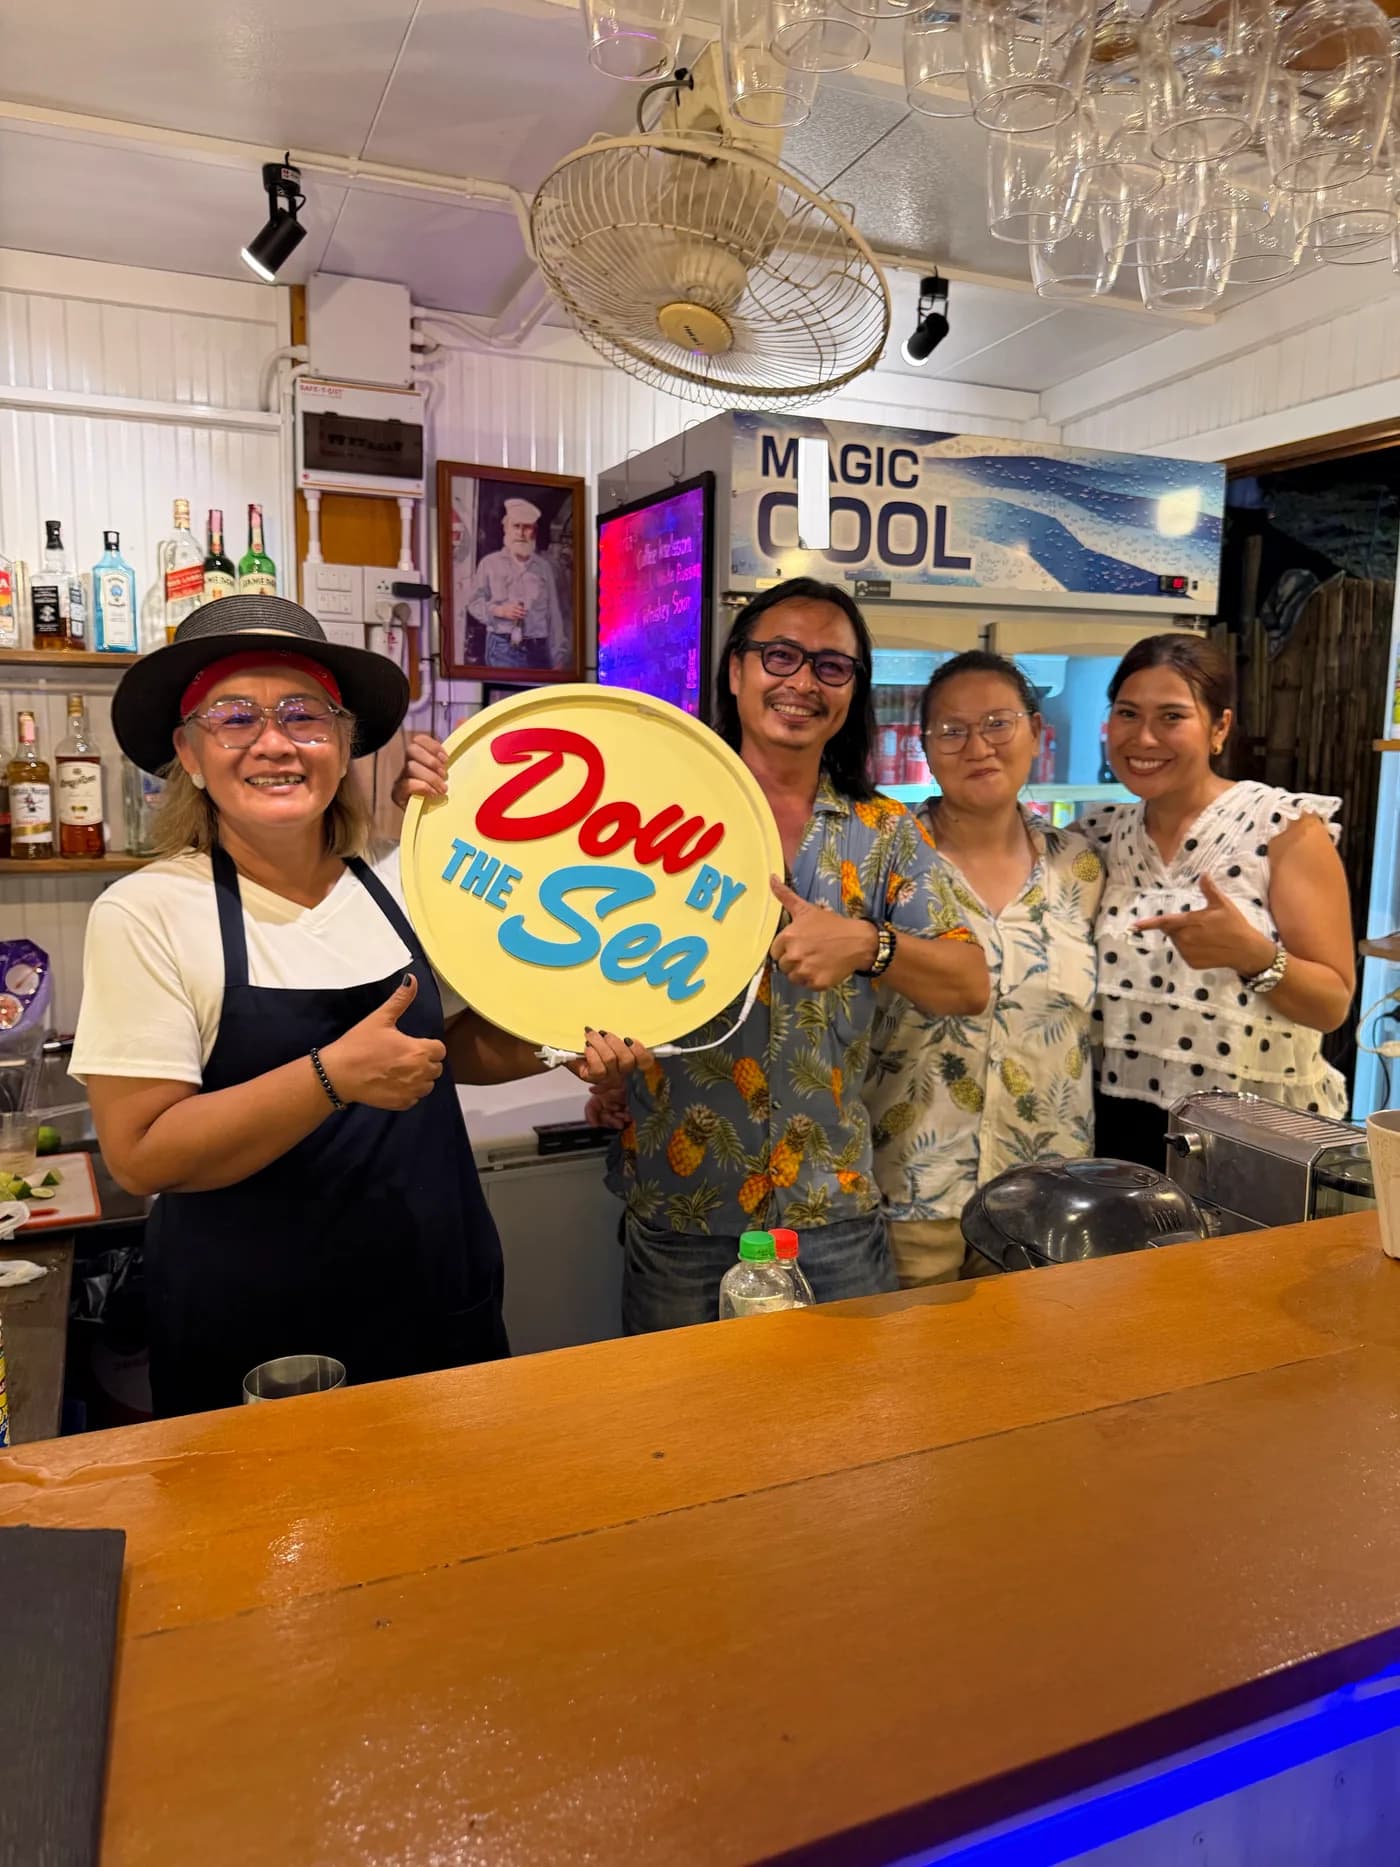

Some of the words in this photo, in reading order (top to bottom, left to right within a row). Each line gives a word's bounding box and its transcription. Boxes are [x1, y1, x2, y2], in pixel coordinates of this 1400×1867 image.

[762, 435, 919, 489] MGIC
[758, 491, 971, 570] COOL
[475, 727, 725, 874] Dow
[684, 863, 748, 922] BY
[441, 837, 523, 912] THE
[497, 865, 709, 1001] Sea
